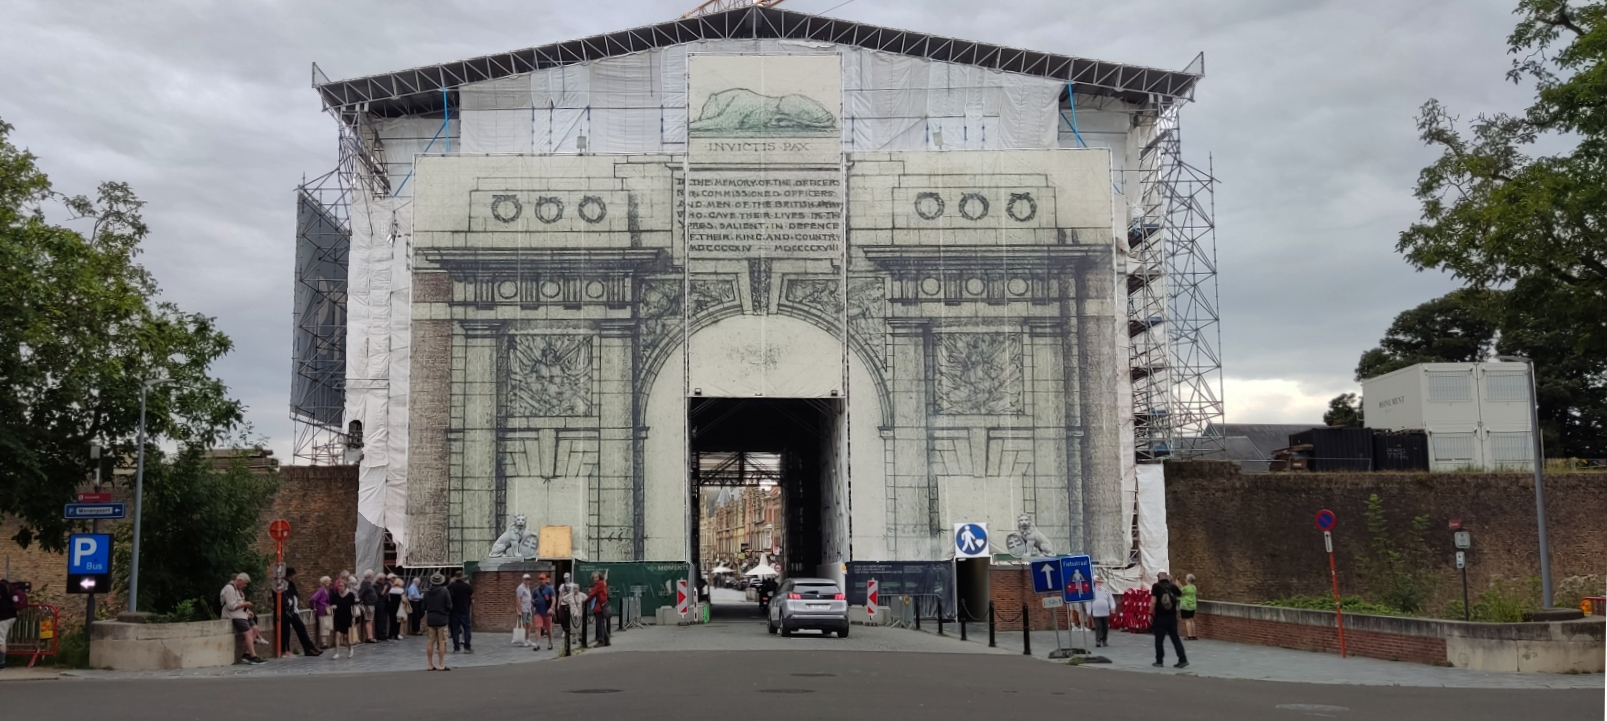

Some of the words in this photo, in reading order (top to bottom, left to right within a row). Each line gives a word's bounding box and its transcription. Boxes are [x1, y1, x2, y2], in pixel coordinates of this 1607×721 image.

[708, 142, 776, 152] INVICTIS
[783, 142, 809, 152] PAX
[714, 179, 756, 187] MEMORY
[771, 222, 783, 230] IN
[788, 222, 840, 230] DEFENCE
[765, 233, 790, 241] AND
[795, 233, 841, 241] COUNTRY
[74, 538, 97, 566] P
[86, 562, 102, 570] Bus
